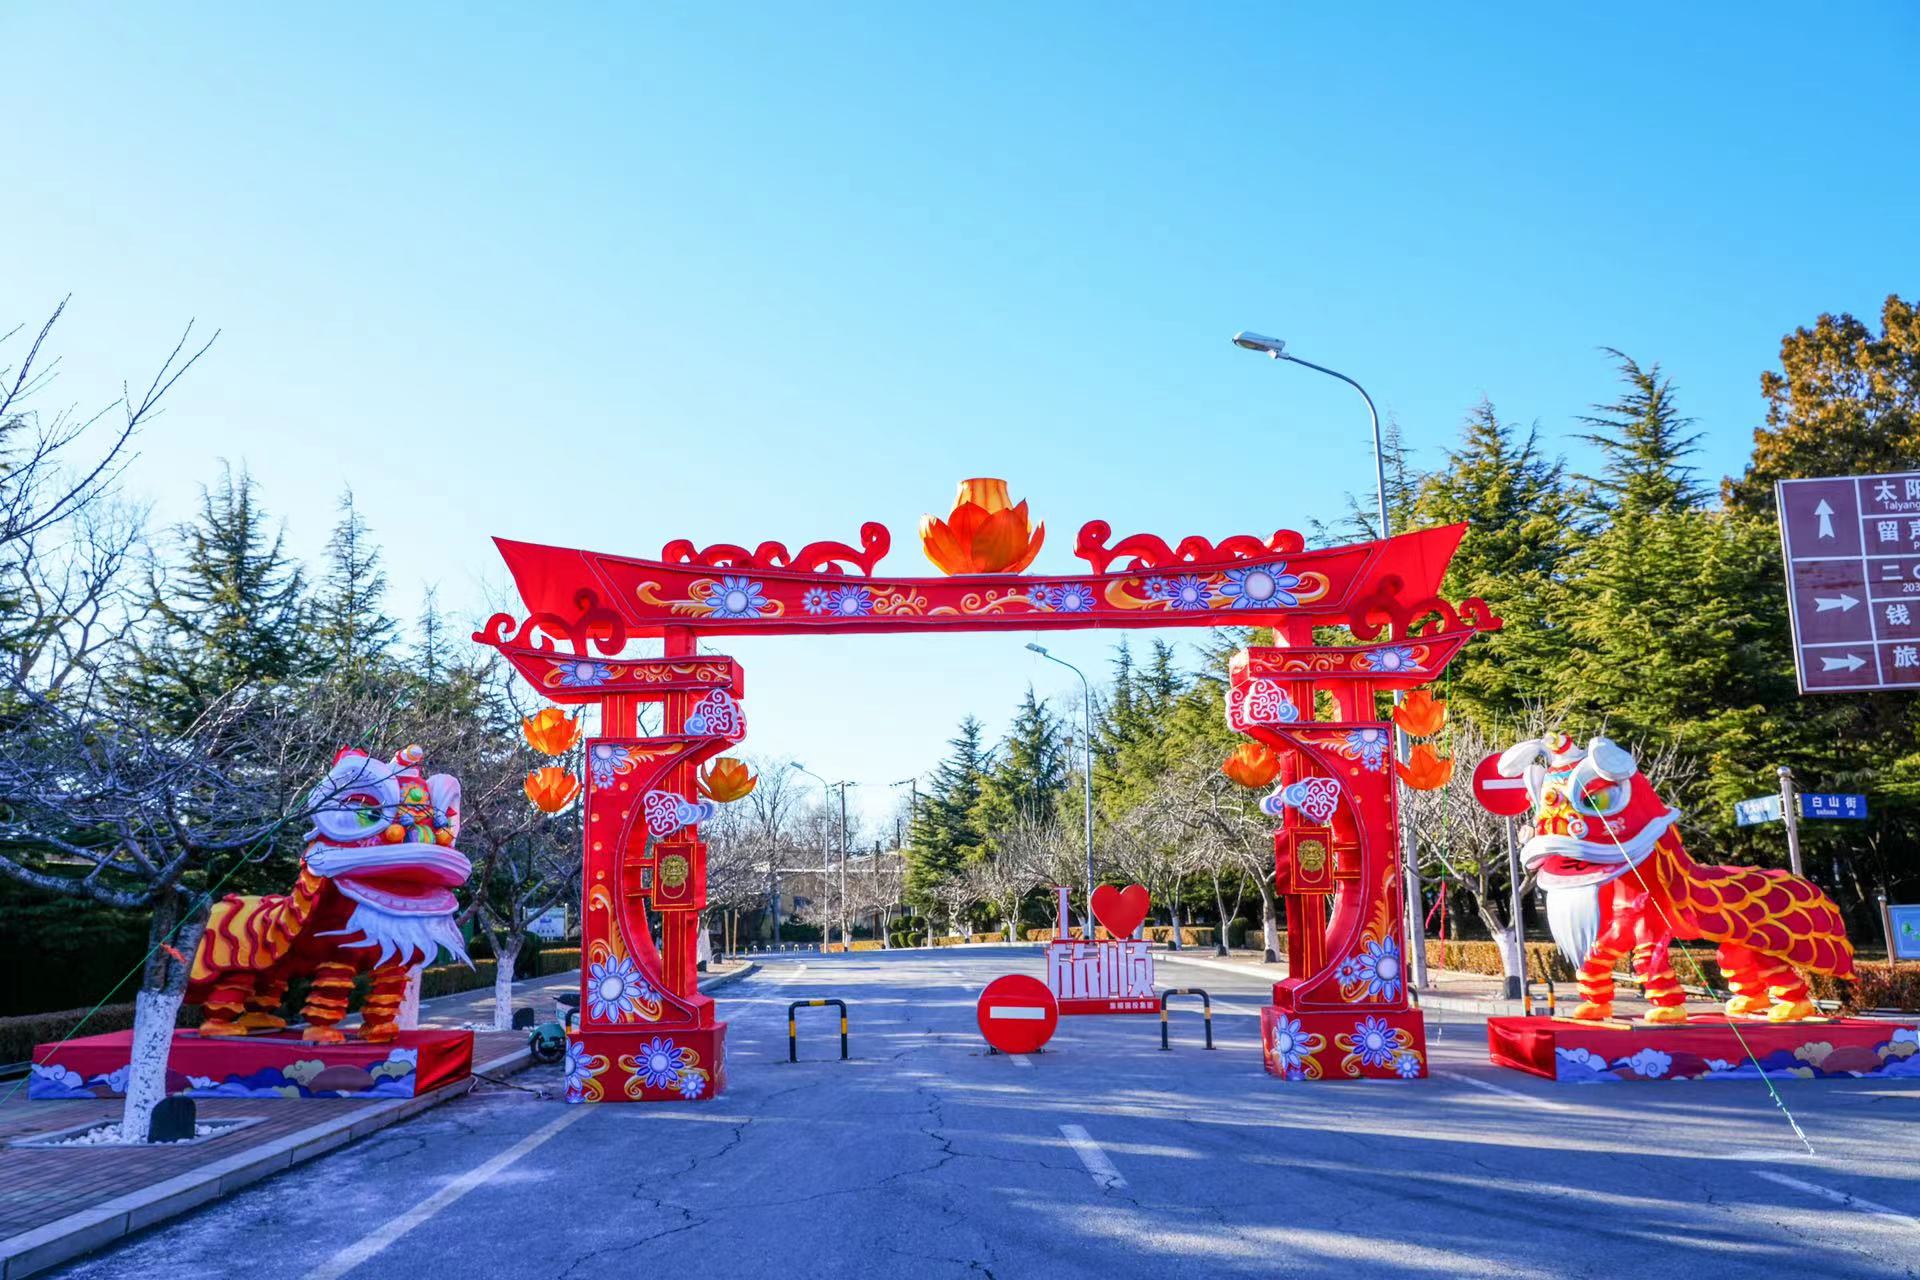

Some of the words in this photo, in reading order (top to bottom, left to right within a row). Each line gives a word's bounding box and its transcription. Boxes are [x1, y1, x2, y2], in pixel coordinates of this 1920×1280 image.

[1886, 604, 1911, 625] 钱
[1812, 796, 1856, 809] 白山街
